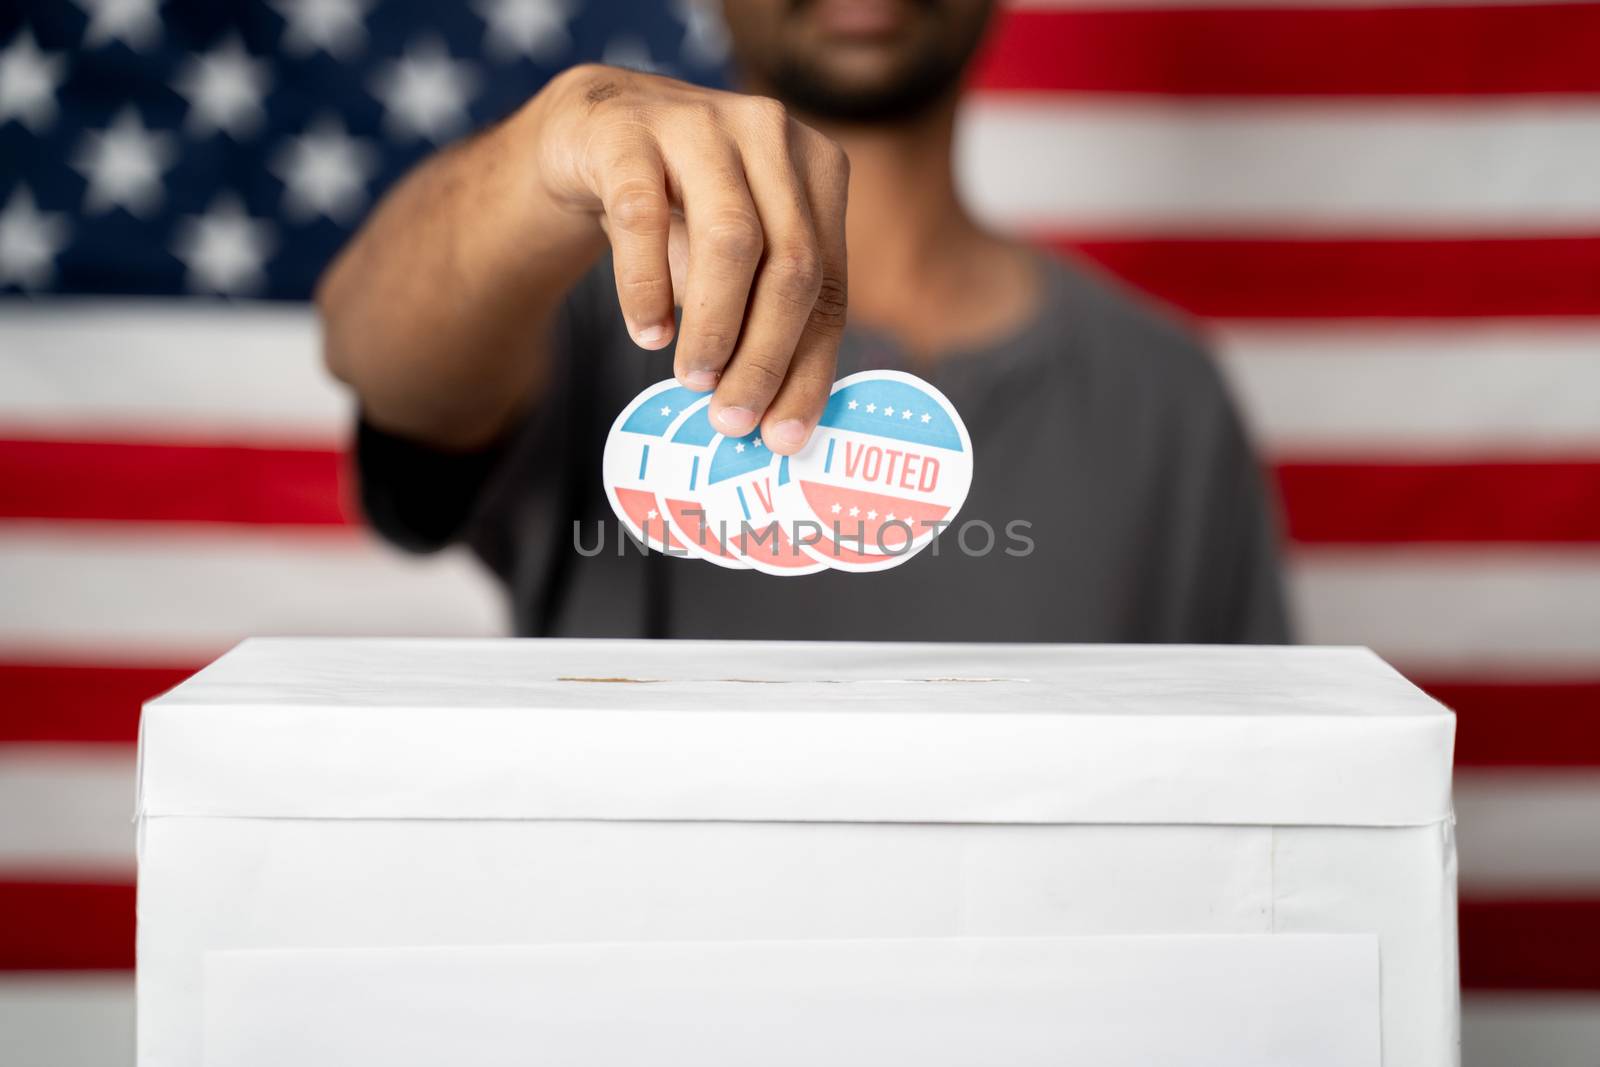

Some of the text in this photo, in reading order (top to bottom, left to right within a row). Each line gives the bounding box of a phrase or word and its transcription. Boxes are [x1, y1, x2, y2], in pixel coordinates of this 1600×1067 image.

[638, 444, 650, 481] I
[689, 455, 700, 492] I
[824, 438, 941, 494] I VOTED
[736, 485, 752, 521] I
